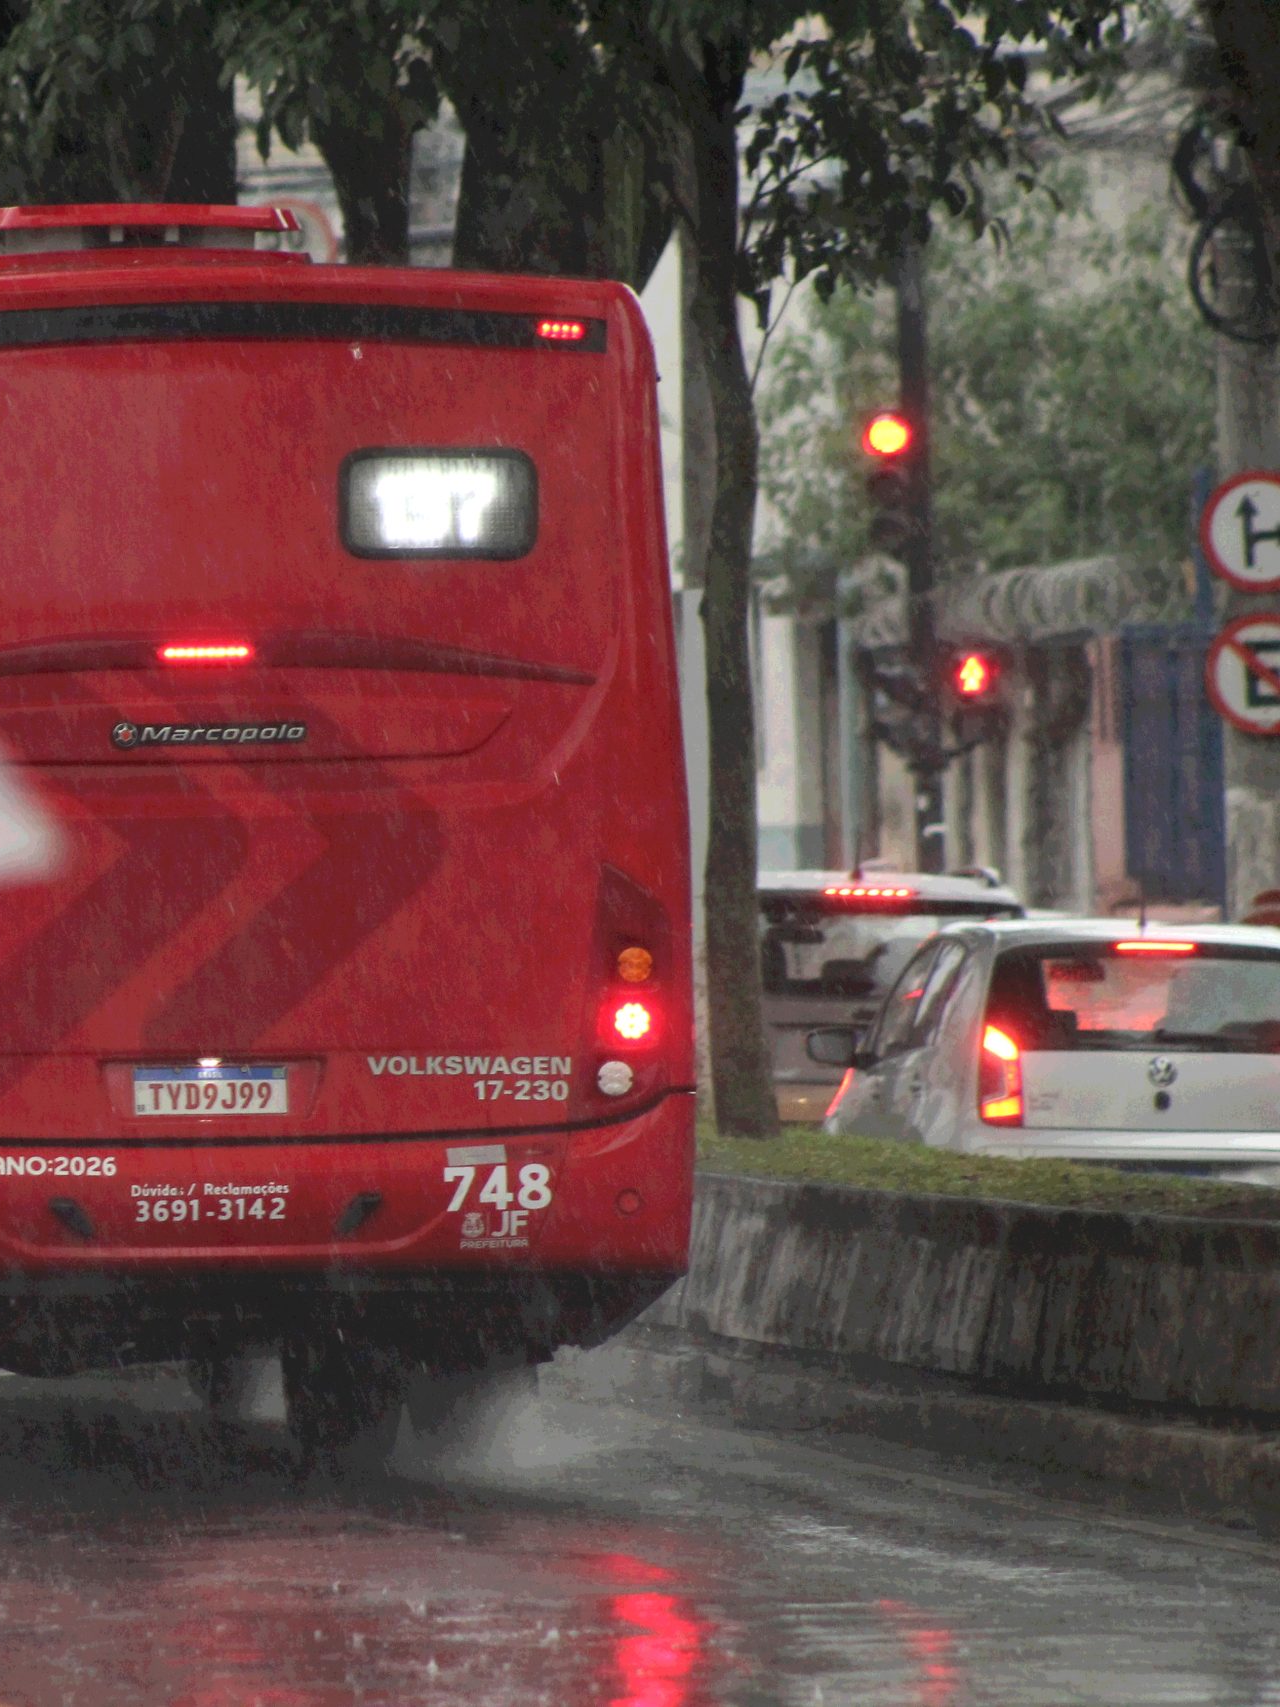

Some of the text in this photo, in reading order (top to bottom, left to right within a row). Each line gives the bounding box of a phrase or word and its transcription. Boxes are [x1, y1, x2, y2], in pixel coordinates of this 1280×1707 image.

[141, 723, 305, 743] Marcopolo
[367, 1056, 572, 1075] VOLKSWAGEN
[149, 1082, 273, 1111] TYD9J99
[473, 1080, 569, 1100] 17-230
[204, 1182, 289, 1196] Reclamações
[443, 1163, 552, 1212] 748
[135, 1197, 286, 1222] 3691-3142
[491, 1210, 529, 1237] JF
[460, 1239, 529, 1249] PREFEITURA
